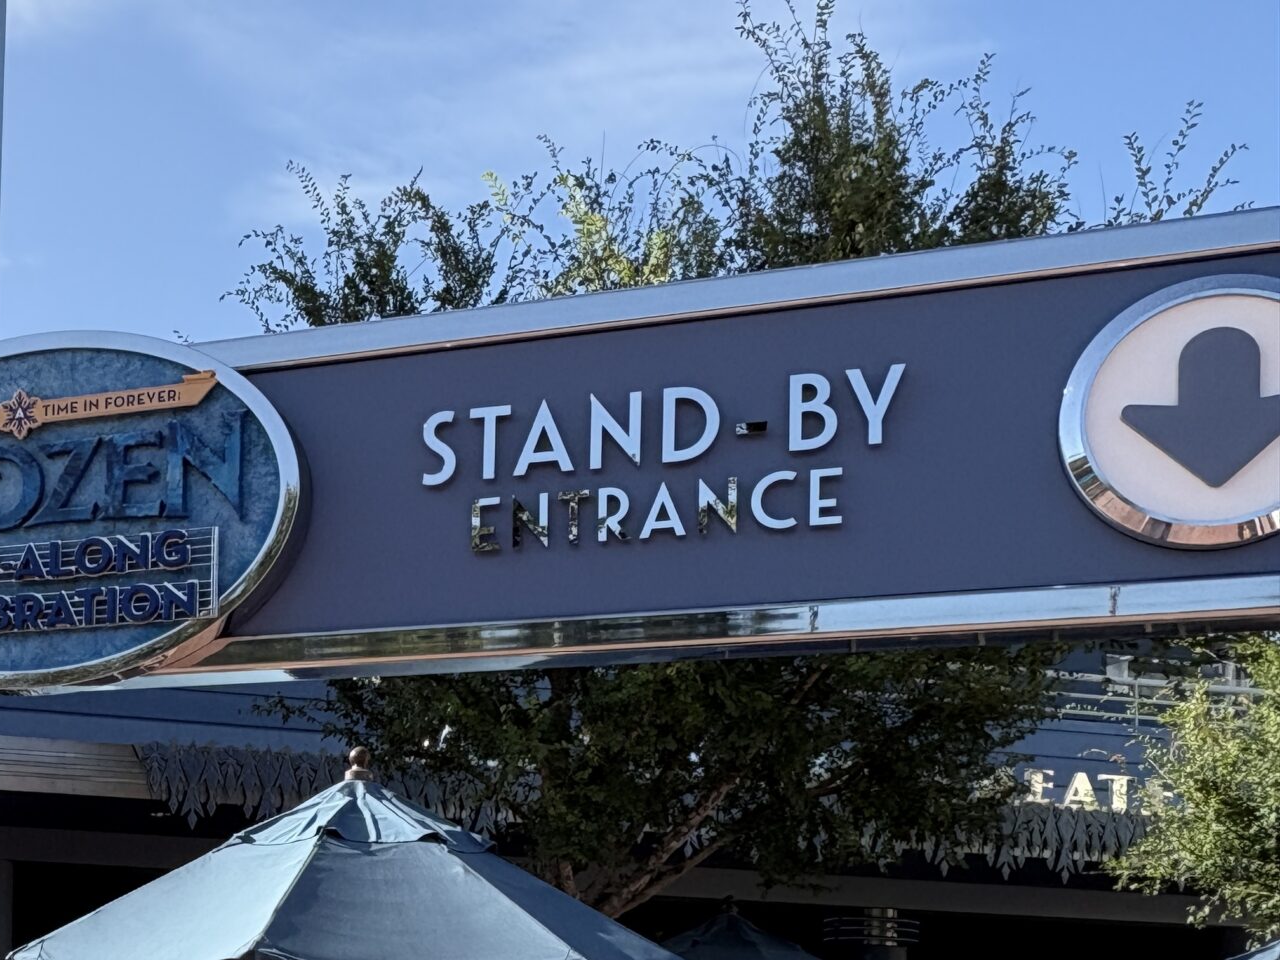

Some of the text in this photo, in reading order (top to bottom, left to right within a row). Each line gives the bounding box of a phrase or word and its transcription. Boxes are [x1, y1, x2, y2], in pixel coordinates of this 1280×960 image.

[42, 401, 79, 417] TIME
[83, 398, 99, 412] IN
[421, 363, 907, 486] STAND-BY
[470, 466, 844, 553] ENTRANCE
